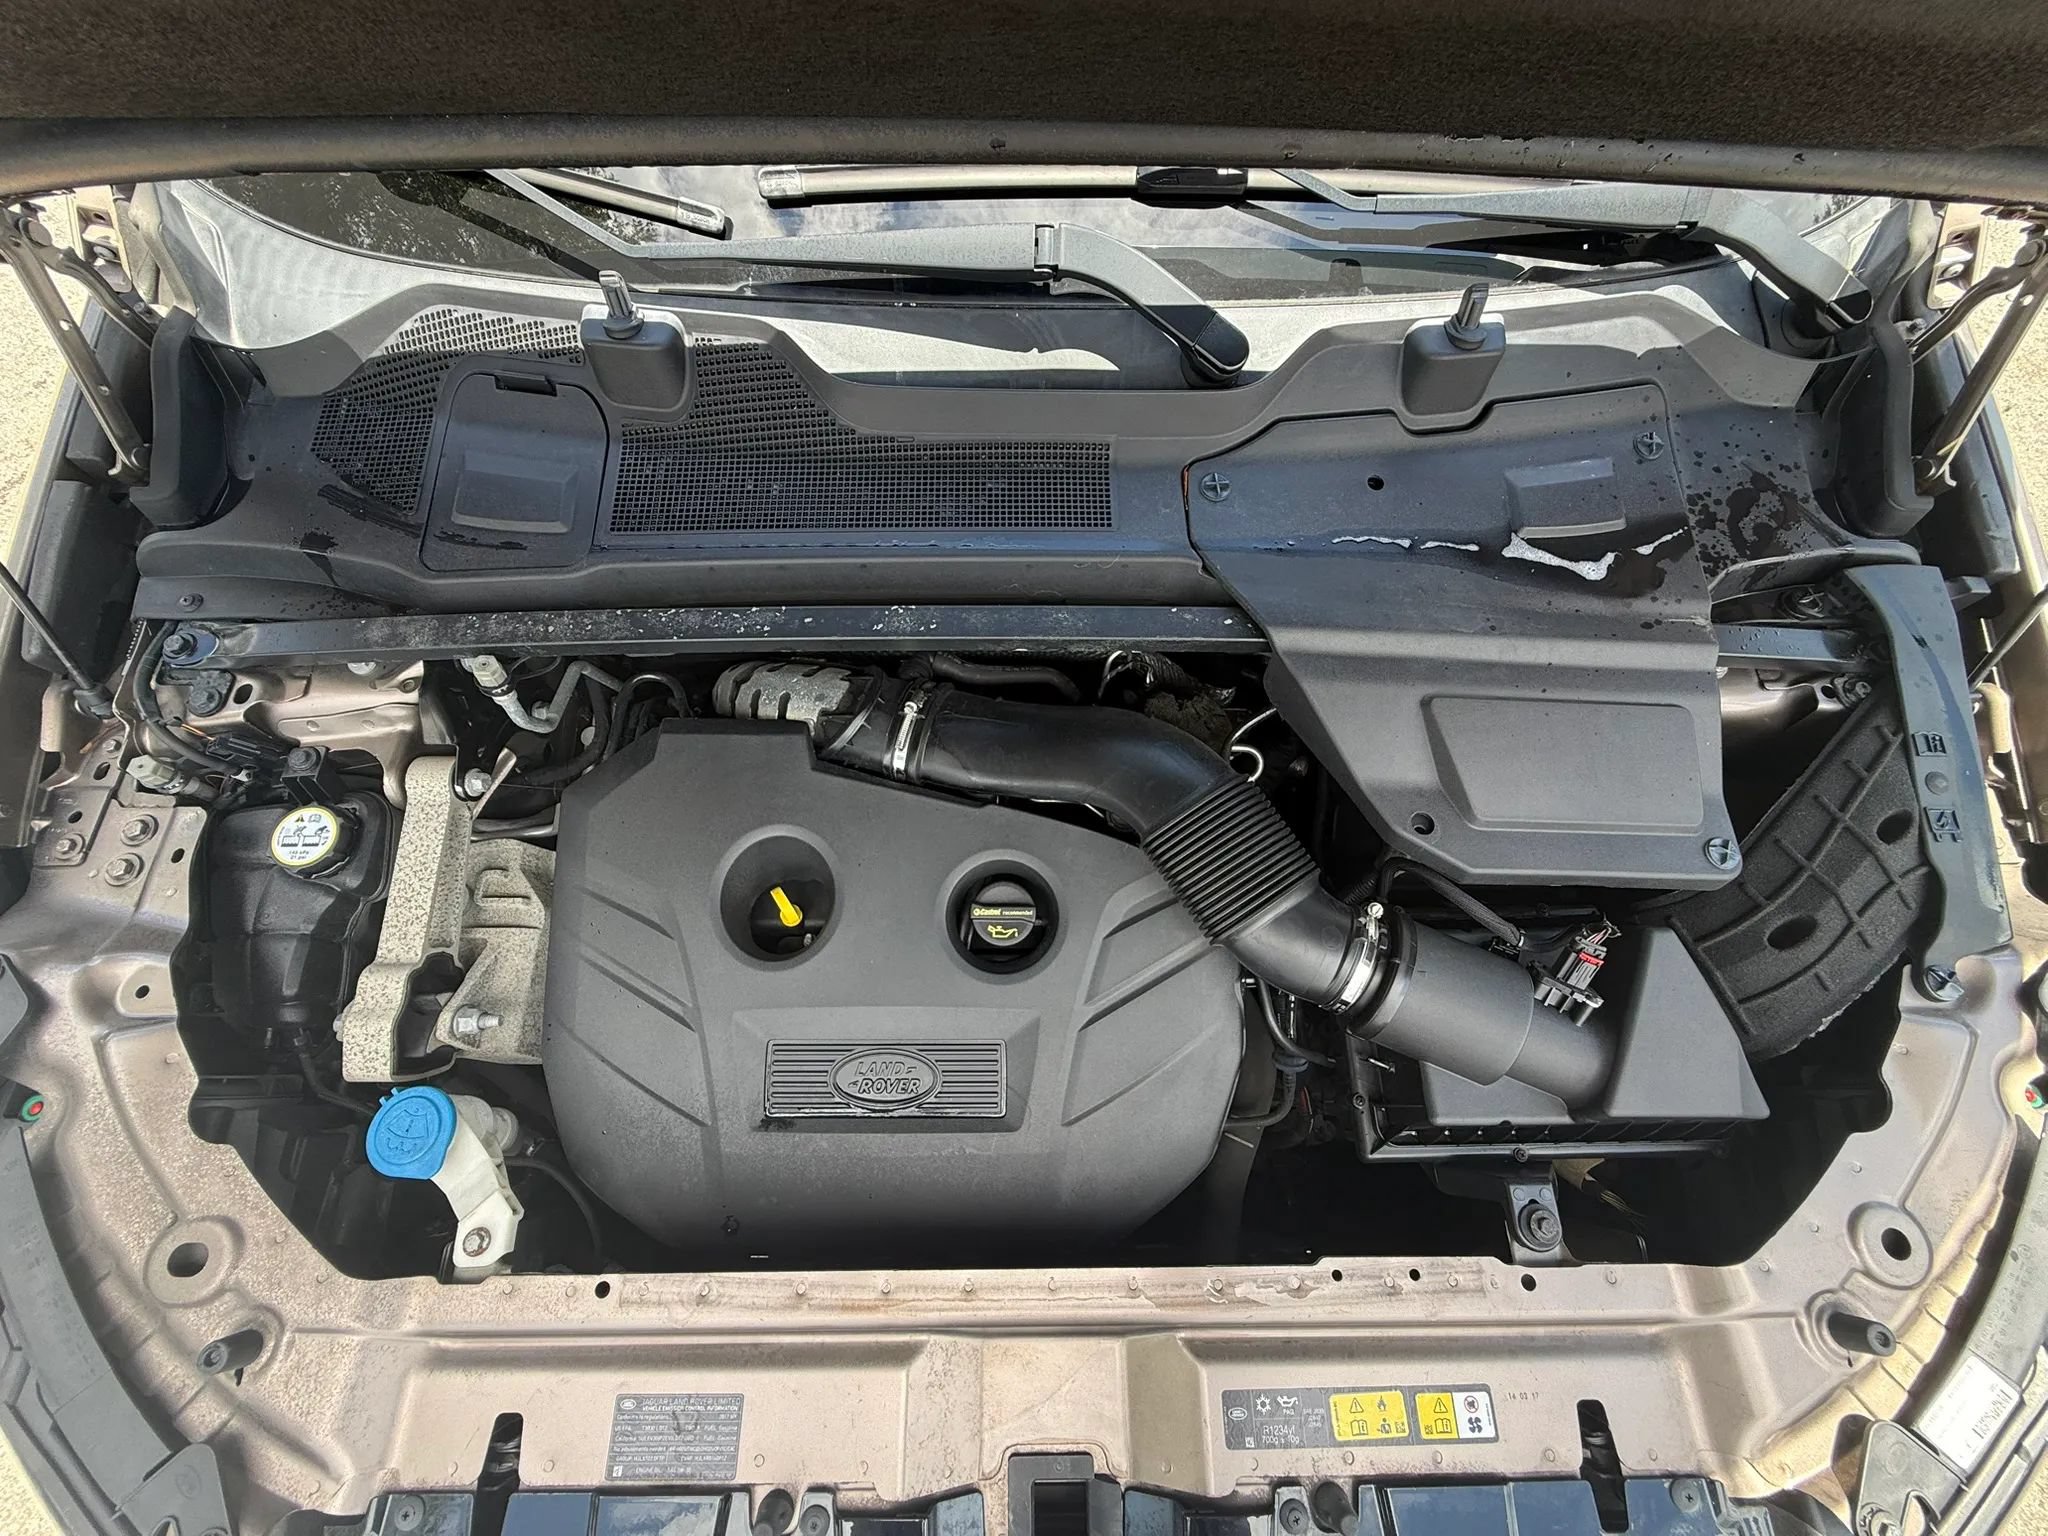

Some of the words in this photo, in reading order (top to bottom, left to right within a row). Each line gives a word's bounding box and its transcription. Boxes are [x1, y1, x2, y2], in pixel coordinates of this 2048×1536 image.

[980, 908, 1002, 916] Castrol
[854, 1061, 906, 1078] LAND
[858, 1078, 921, 1095] ROVER
[642, 1397, 668, 1406] JAGUAR
[669, 1397, 688, 1405] LAND
[690, 1397, 712, 1405] ROVER
[714, 1397, 740, 1405] LIMITED
[1263, 1425, 1296, 1436] R1234yf
[1262, 1436, 1279, 1445] 700g
